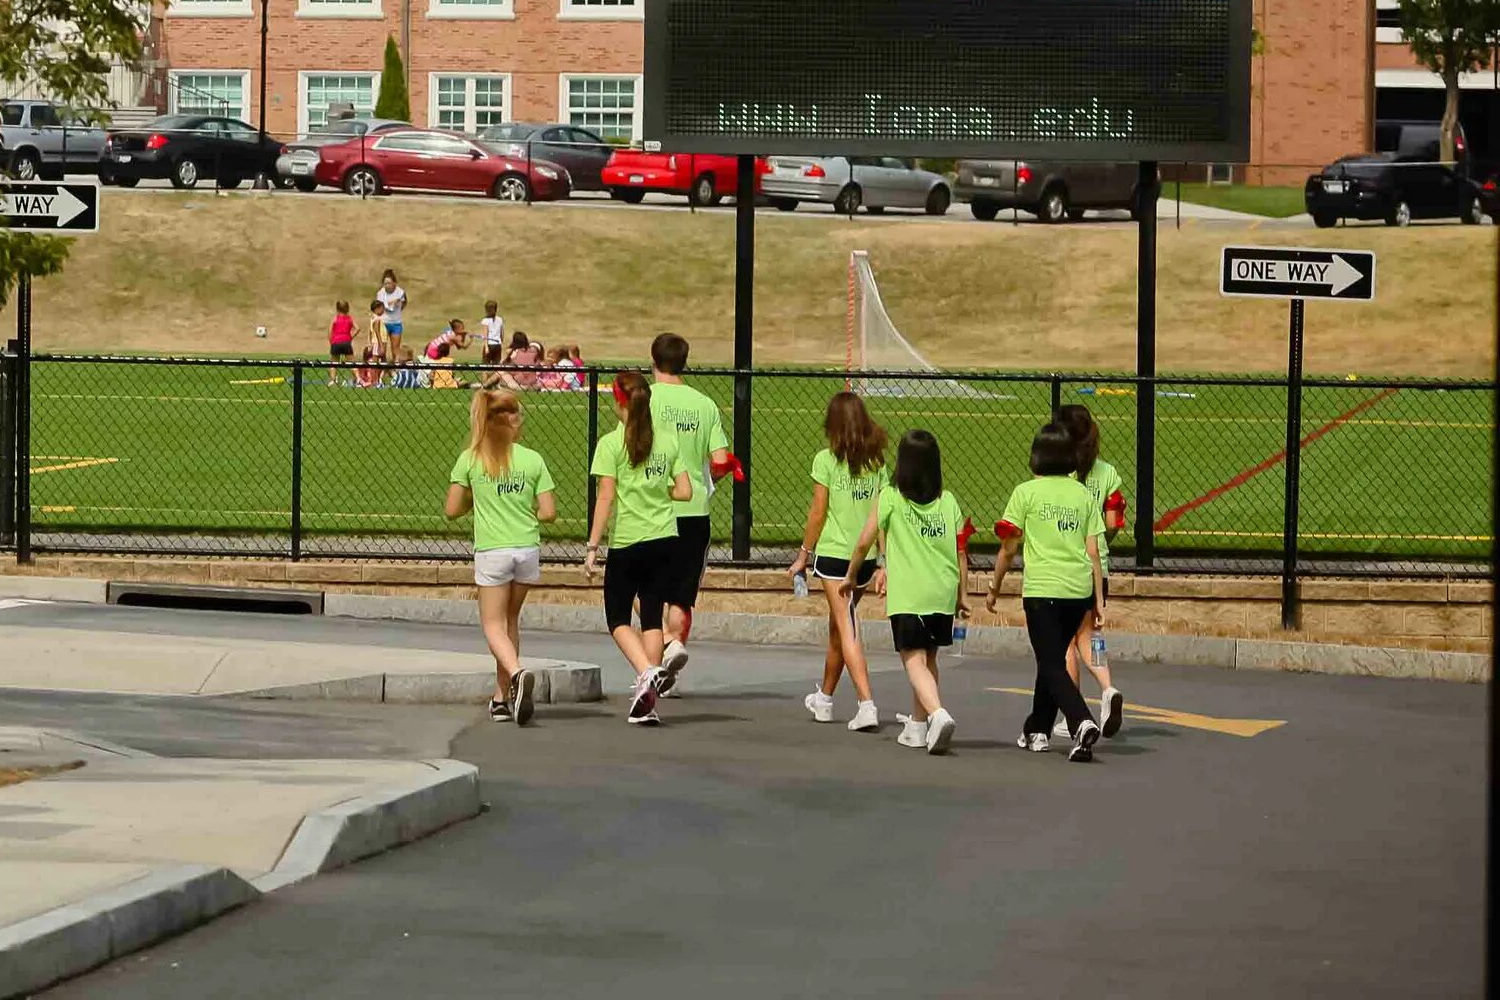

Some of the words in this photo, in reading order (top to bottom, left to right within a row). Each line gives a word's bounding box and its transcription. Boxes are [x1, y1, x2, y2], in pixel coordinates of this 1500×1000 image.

[15, 196, 55, 214] WAY
[1237, 260, 1276, 280] ONE
[1288, 263, 1329, 282] WAY
[497, 481, 525, 496] plus!
[921, 522, 946, 538] plus!
